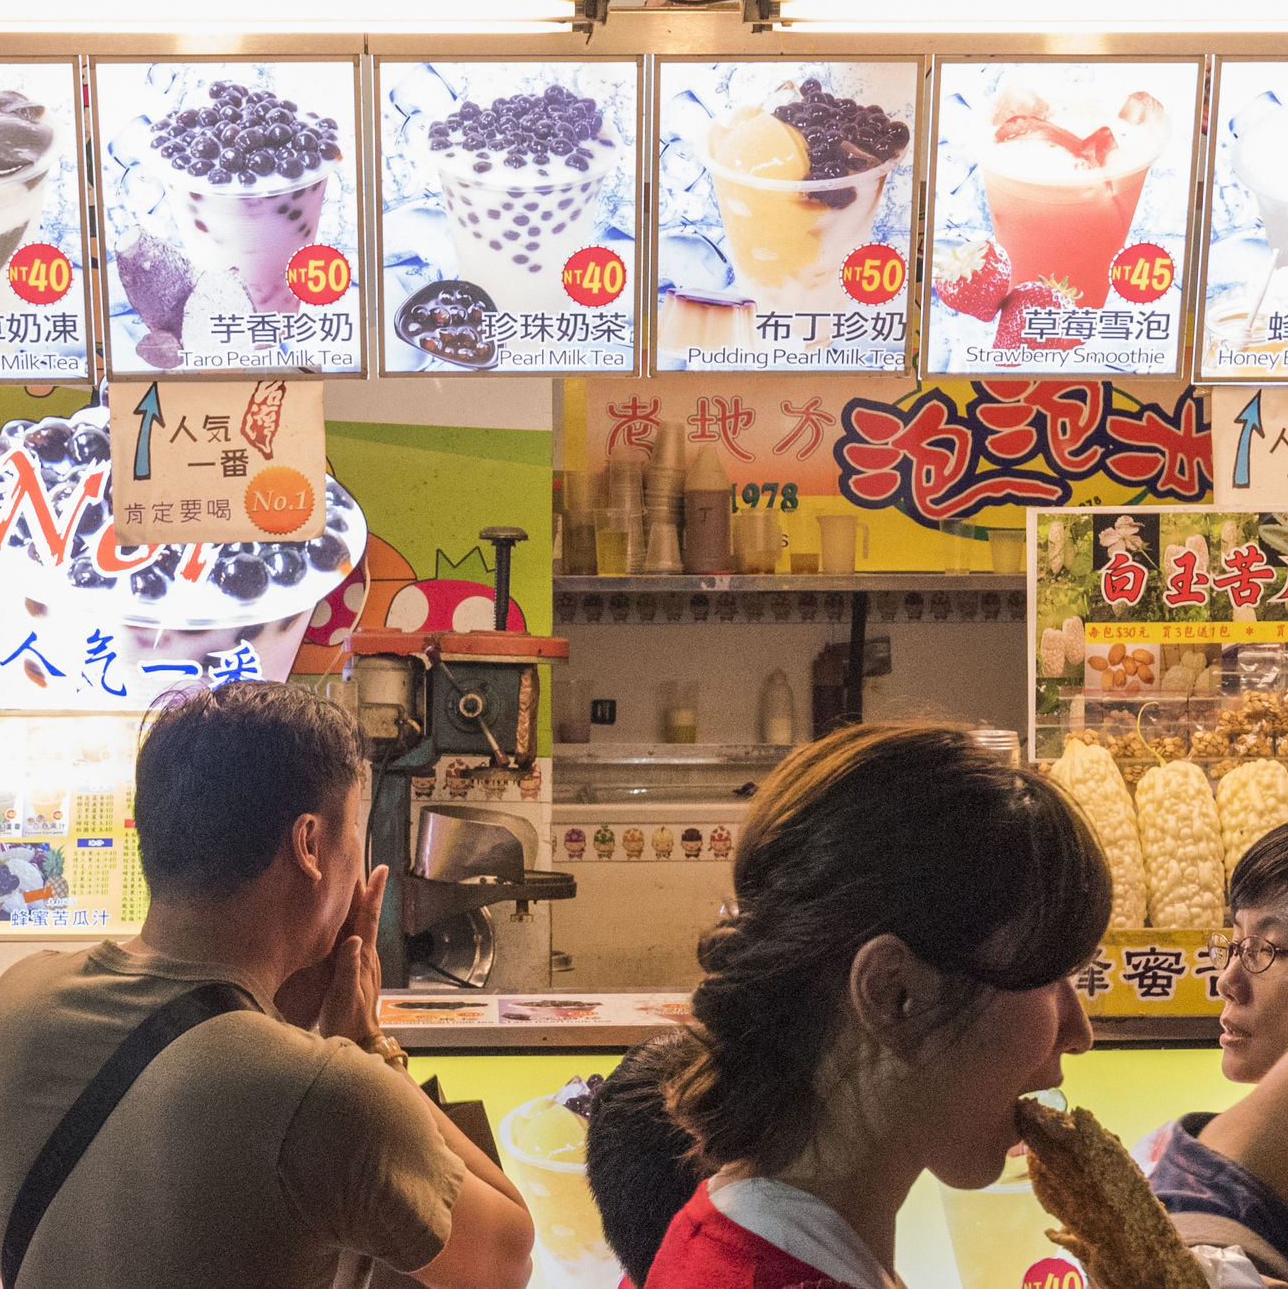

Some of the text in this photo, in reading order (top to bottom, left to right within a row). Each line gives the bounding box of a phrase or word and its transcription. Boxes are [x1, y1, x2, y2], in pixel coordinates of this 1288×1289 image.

[756, 311, 905, 342] 布丁珍奶
[1024, 310, 1171, 341] 草莓雪泡
[688, 348, 905, 369] Pudding Pearl Milk Tea
[966, 347, 1165, 368] Strawberry Smoothie
[1219, 349, 1279, 370] Honey
[170, 414, 231, 444] 人気
[606, 395, 836, 463] 老地方
[188, 450, 249, 478] 一番
[124, 500, 231, 526] 肯定要喝
[252, 491, 309, 514] No.1
